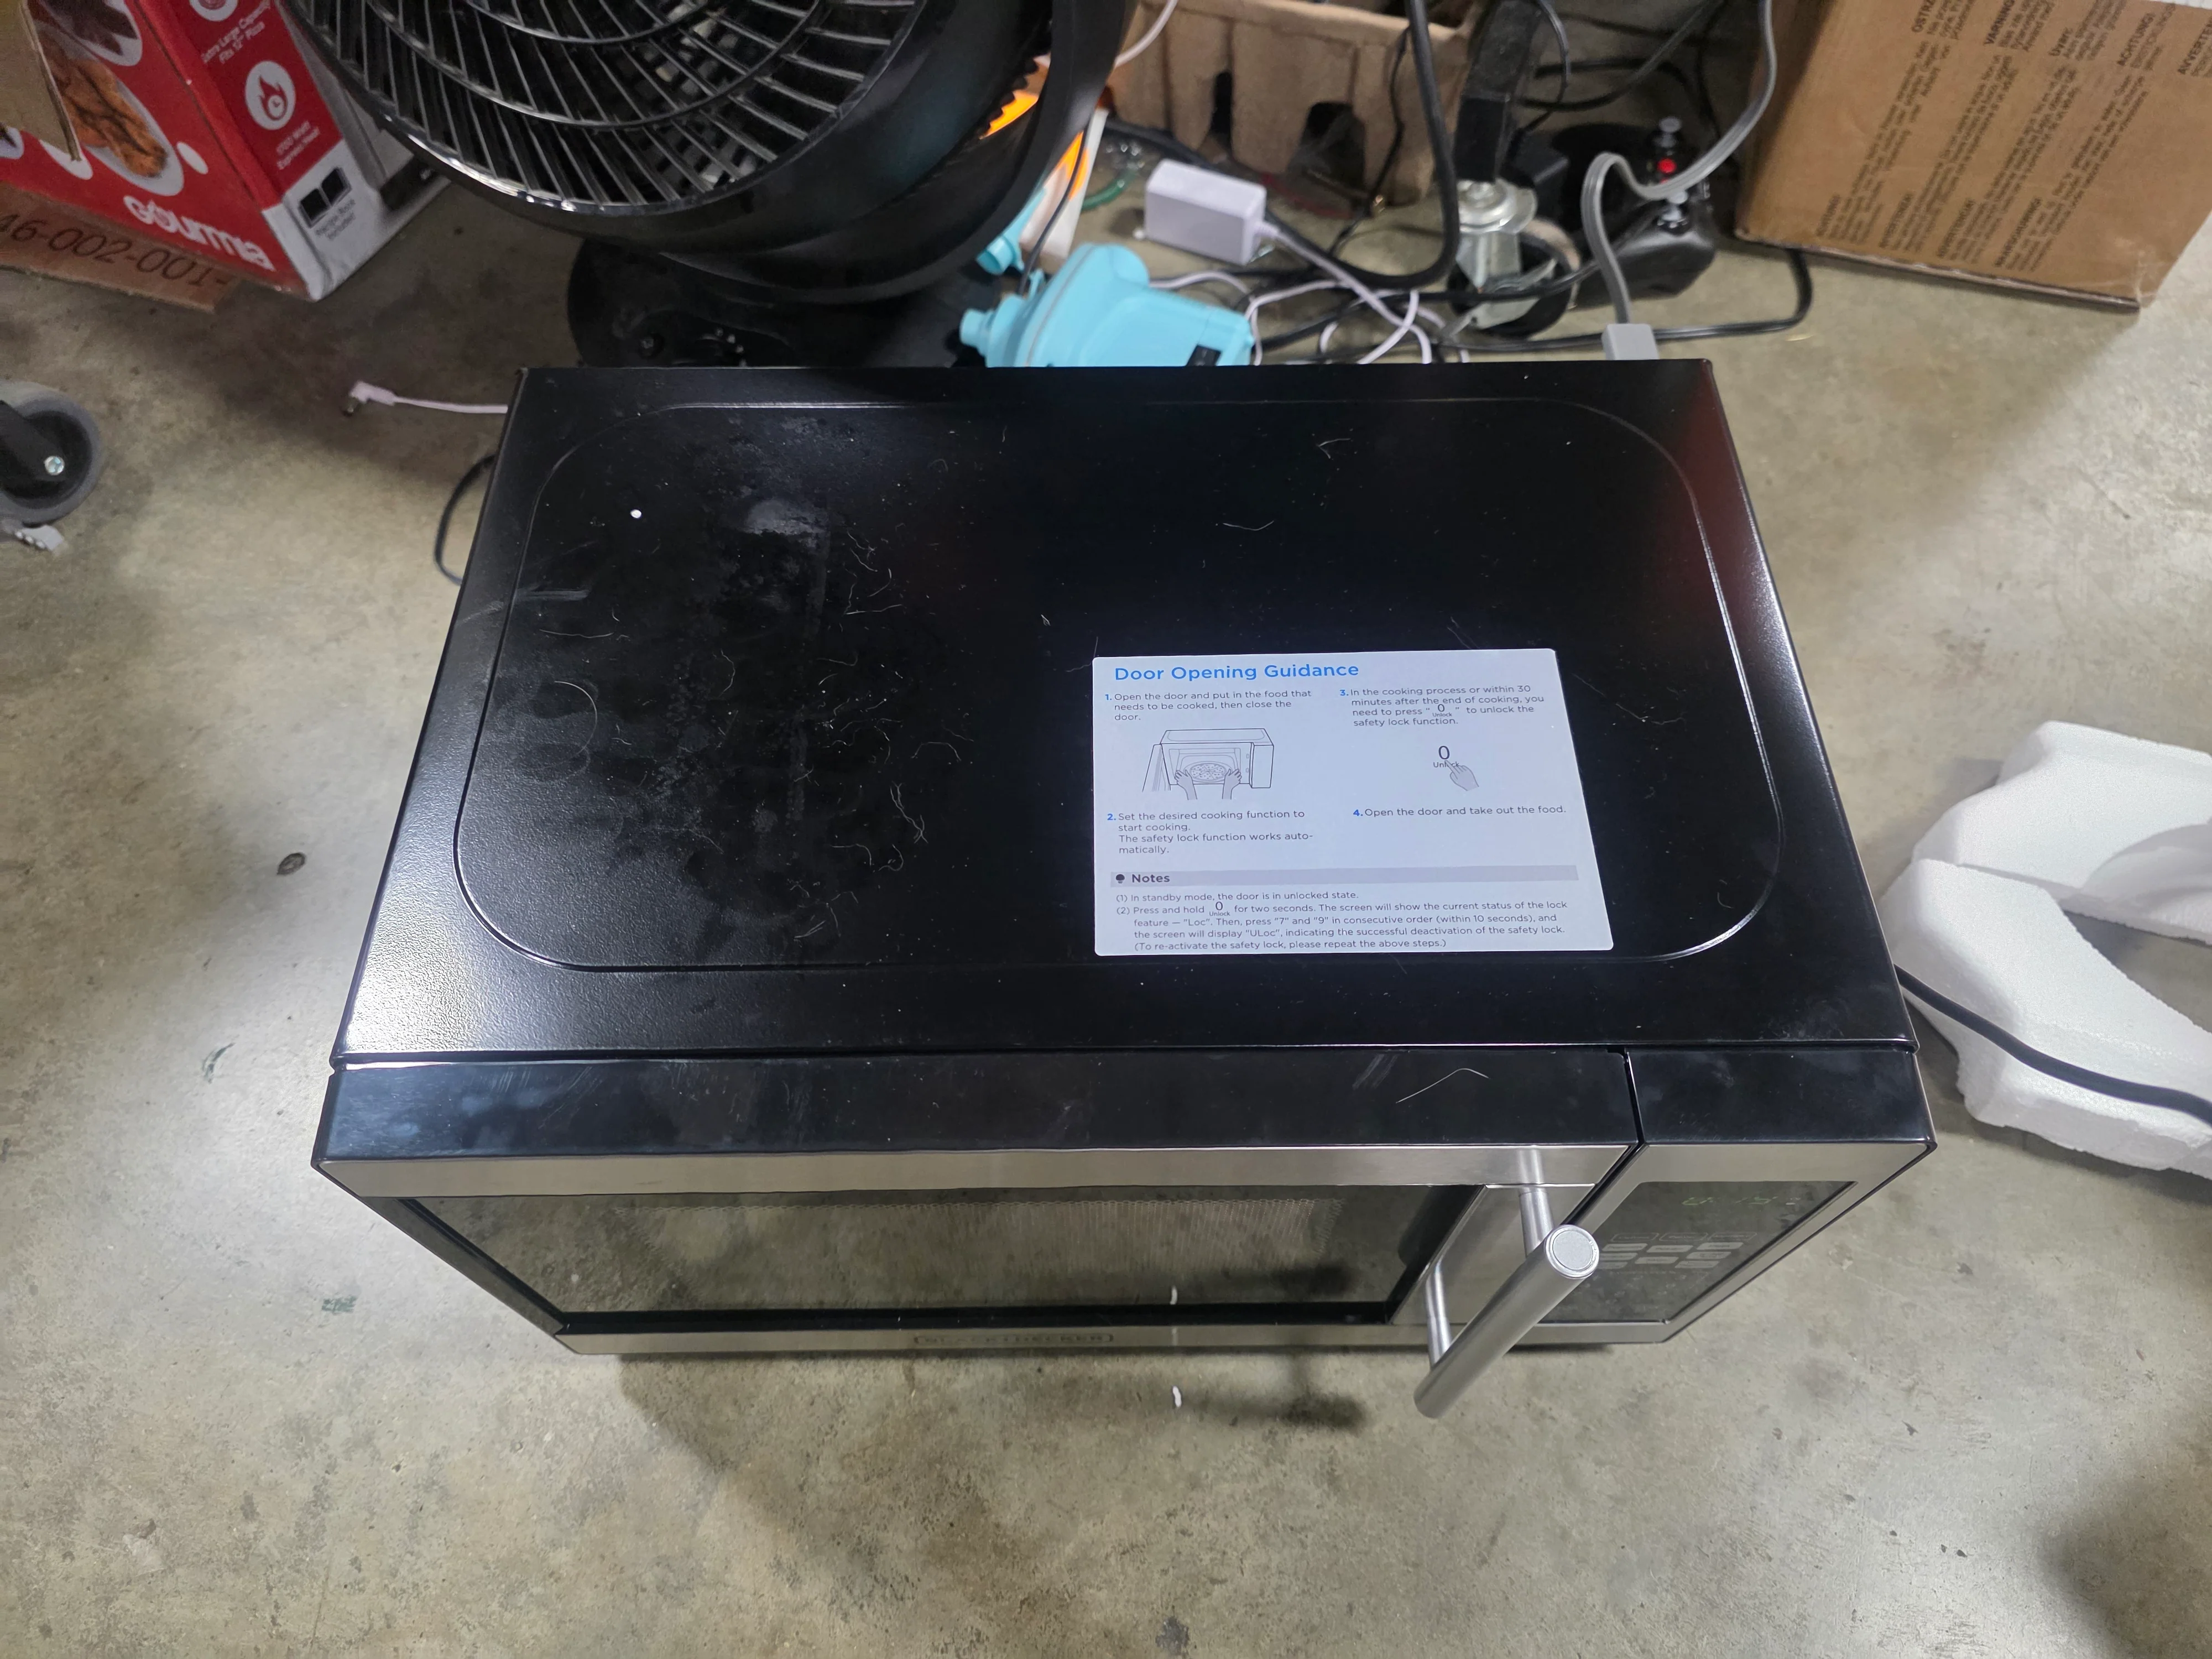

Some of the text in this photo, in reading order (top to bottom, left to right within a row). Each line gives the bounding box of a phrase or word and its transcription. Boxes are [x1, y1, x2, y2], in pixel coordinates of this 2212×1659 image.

[1115, 664, 1359, 682] Door Opening Guidance
[1114, 693, 1141, 702] Open
[1144, 692, 1161, 701] the
[1213, 692, 1230, 701] put
[1382, 687, 1423, 696] cooking
[1177, 701, 1217, 709] cooked,
[1220, 701, 1243, 709] then
[1245, 700, 1272, 708] close
[1275, 700, 1292, 708] the
[1464, 696, 1476, 704] of
[1478, 695, 1522, 704] cooking,
[1352, 708, 1378, 716] need
[1479, 705, 1515, 713] unlock
[1353, 718, 1385, 727] safety
[1388, 717, 1410, 726] lock
[1139, 812, 1156, 821] the
[1159, 811, 1197, 820] desired
[1201, 811, 1243, 820] cooking
[1246, 810, 1290, 819] function
[1364, 808, 1394, 818] Open
[1417, 807, 1443, 816] door
[1446, 807, 1467, 815] and
[1469, 806, 1493, 815] take
[1517, 806, 1535, 814] the
[1537, 805, 1567, 813] food.
[1118, 822, 1191, 832] start cooking.
[1118, 834, 1138, 843] The
[1141, 834, 1174, 843] safety
[1177, 833, 1199, 842] lock
[1202, 833, 1246, 842] function
[1249, 832, 1281, 841] works
[1119, 845, 1170, 855] matically.
[1131, 874, 1171, 883] Notes
[1116, 894, 1128, 903] (1)
[1142, 893, 1182, 902] standby
[1184, 893, 1215, 901] mode,
[1284, 891, 1329, 900] unlocked
[1116, 906, 1130, 915] (2)
[1162, 906, 1181, 914] and
[1183, 905, 1205, 914] hold
[1234, 905, 1249, 913] for
[1272, 904, 1316, 912] seconds.
[1318, 904, 1337, 912] The
[1394, 902, 1421, 911] show
[1514, 901, 1525, 909] of
[1527, 901, 1544, 909] the
[1183, 918, 1213, 926] "Loc".
[1215, 917, 1243, 926] Then,
[1274, 917, 1289, 925] "7"
[1292, 916, 1311, 925] and
[1313, 916, 1329, 925] "9"
[1332, 916, 1341, 925] in
[1343, 915, 1404, 924] consecutive
[1406, 915, 1433, 924] order
[1436, 915, 1471, 924] (within
[1487, 914, 1536, 923] seconds),
[1538, 914, 1557, 922] and
[1188, 930, 1204, 938] will
[1207, 930, 1243, 939] display
[1245, 928, 1283, 937] "ULoc",
[1285, 928, 1334, 938] indicating
[1356, 926, 1408, 936] successful
[1410, 926, 1473, 935] deactivation
[1475, 926, 1486, 934] of
[1507, 926, 1538, 935] safety
[1541, 925, 1565, 933] lock.
[1134, 938, 1447, 952] (To re-activate the safety lock, please repeat the above steps.)
